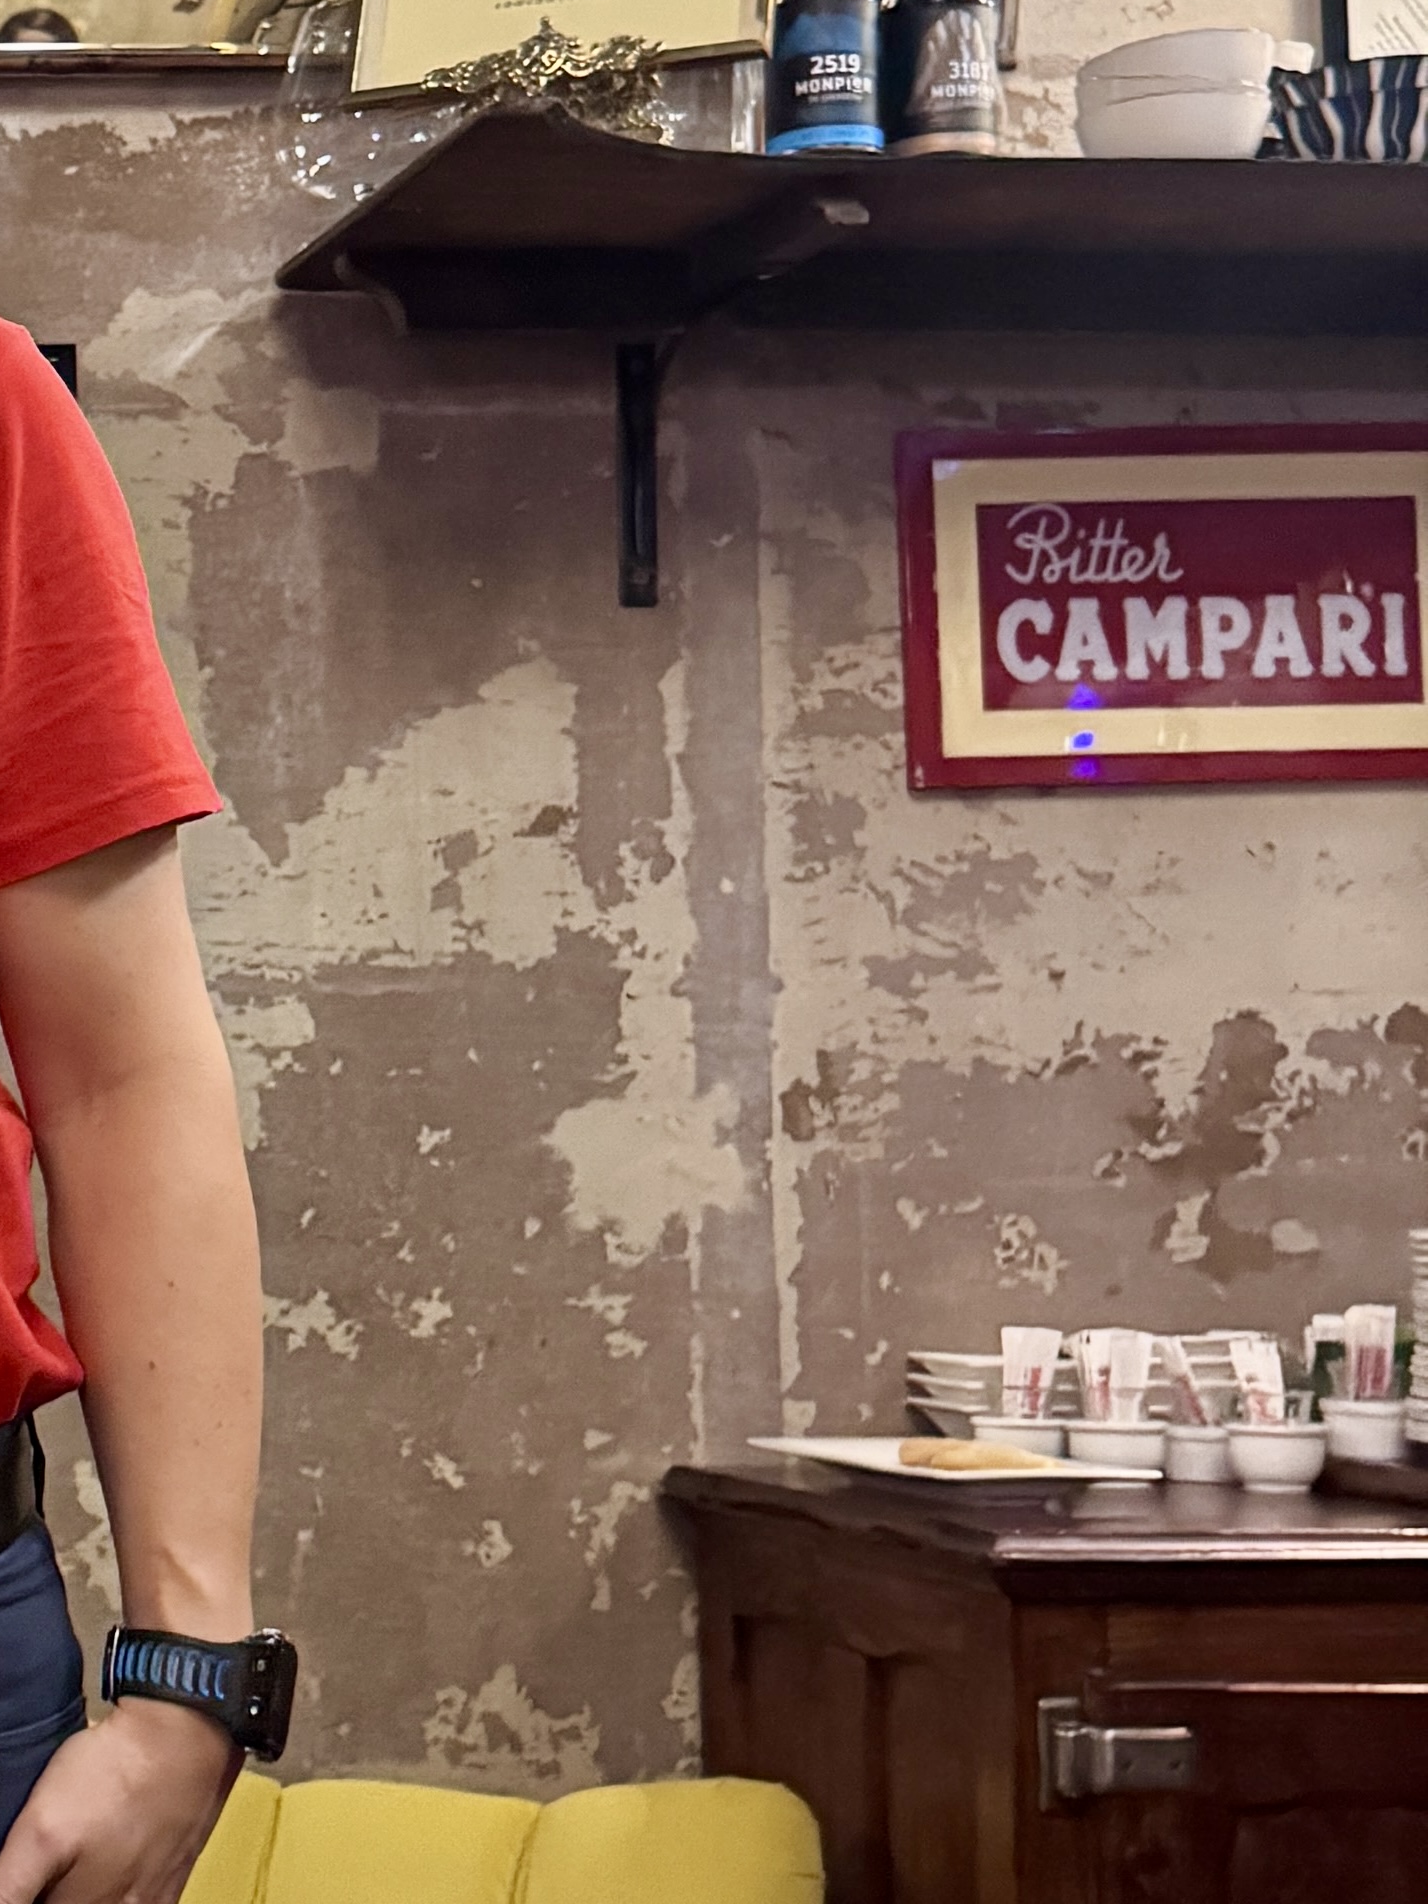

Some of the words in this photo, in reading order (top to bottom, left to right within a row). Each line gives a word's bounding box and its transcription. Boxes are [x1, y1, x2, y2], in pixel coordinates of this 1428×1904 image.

[810, 53, 861, 75] 2519
[1006, 503, 1185, 584] Bitter
[996, 593, 1408, 683] CAMPARI
